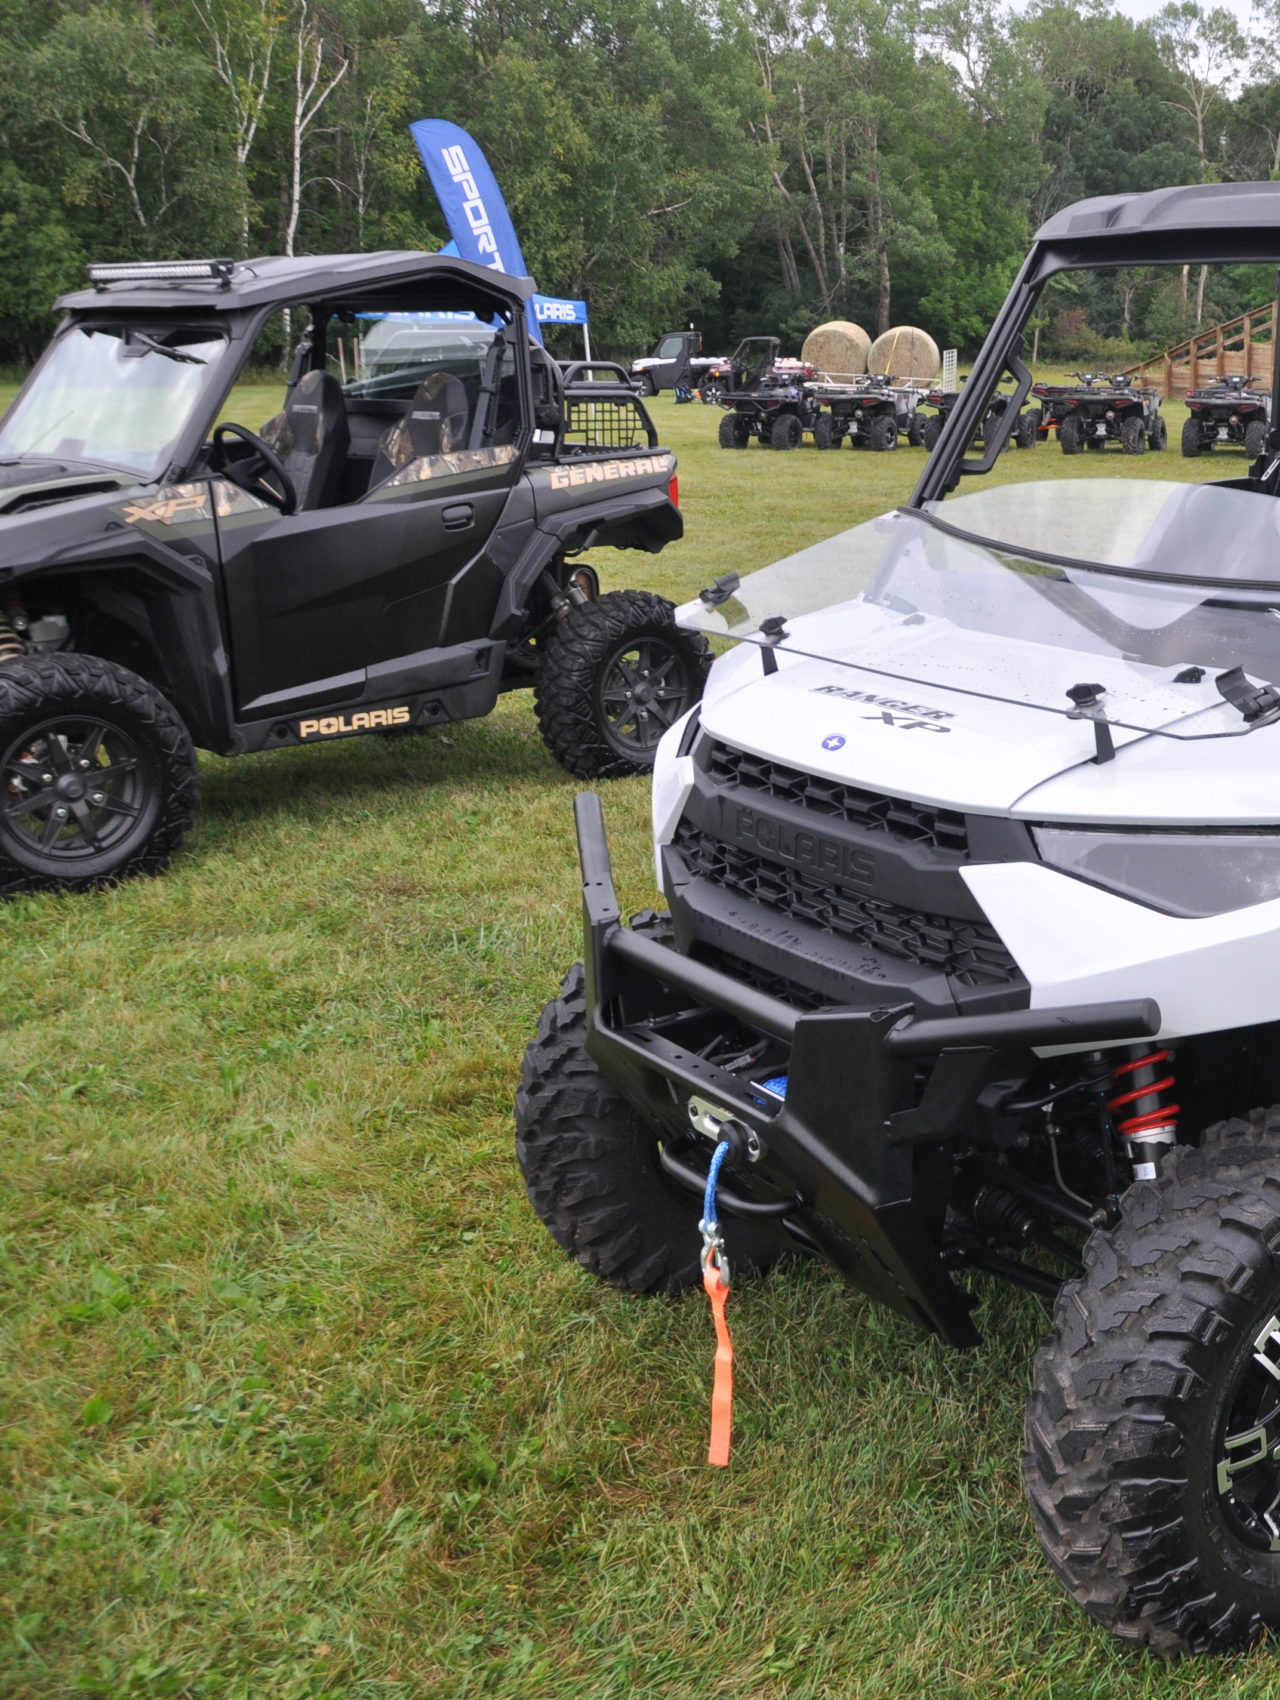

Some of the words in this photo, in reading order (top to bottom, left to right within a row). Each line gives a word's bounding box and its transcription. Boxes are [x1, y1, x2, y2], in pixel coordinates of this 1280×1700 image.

[534, 302, 577, 320] LARIS
[550, 456, 668, 490] GENERAL
[122, 494, 208, 525] XP
[810, 685, 957, 721] RANGER
[300, 705, 412, 739] POLARIS
[858, 710, 952, 734] XP
[738, 813, 876, 887] POLARIS
